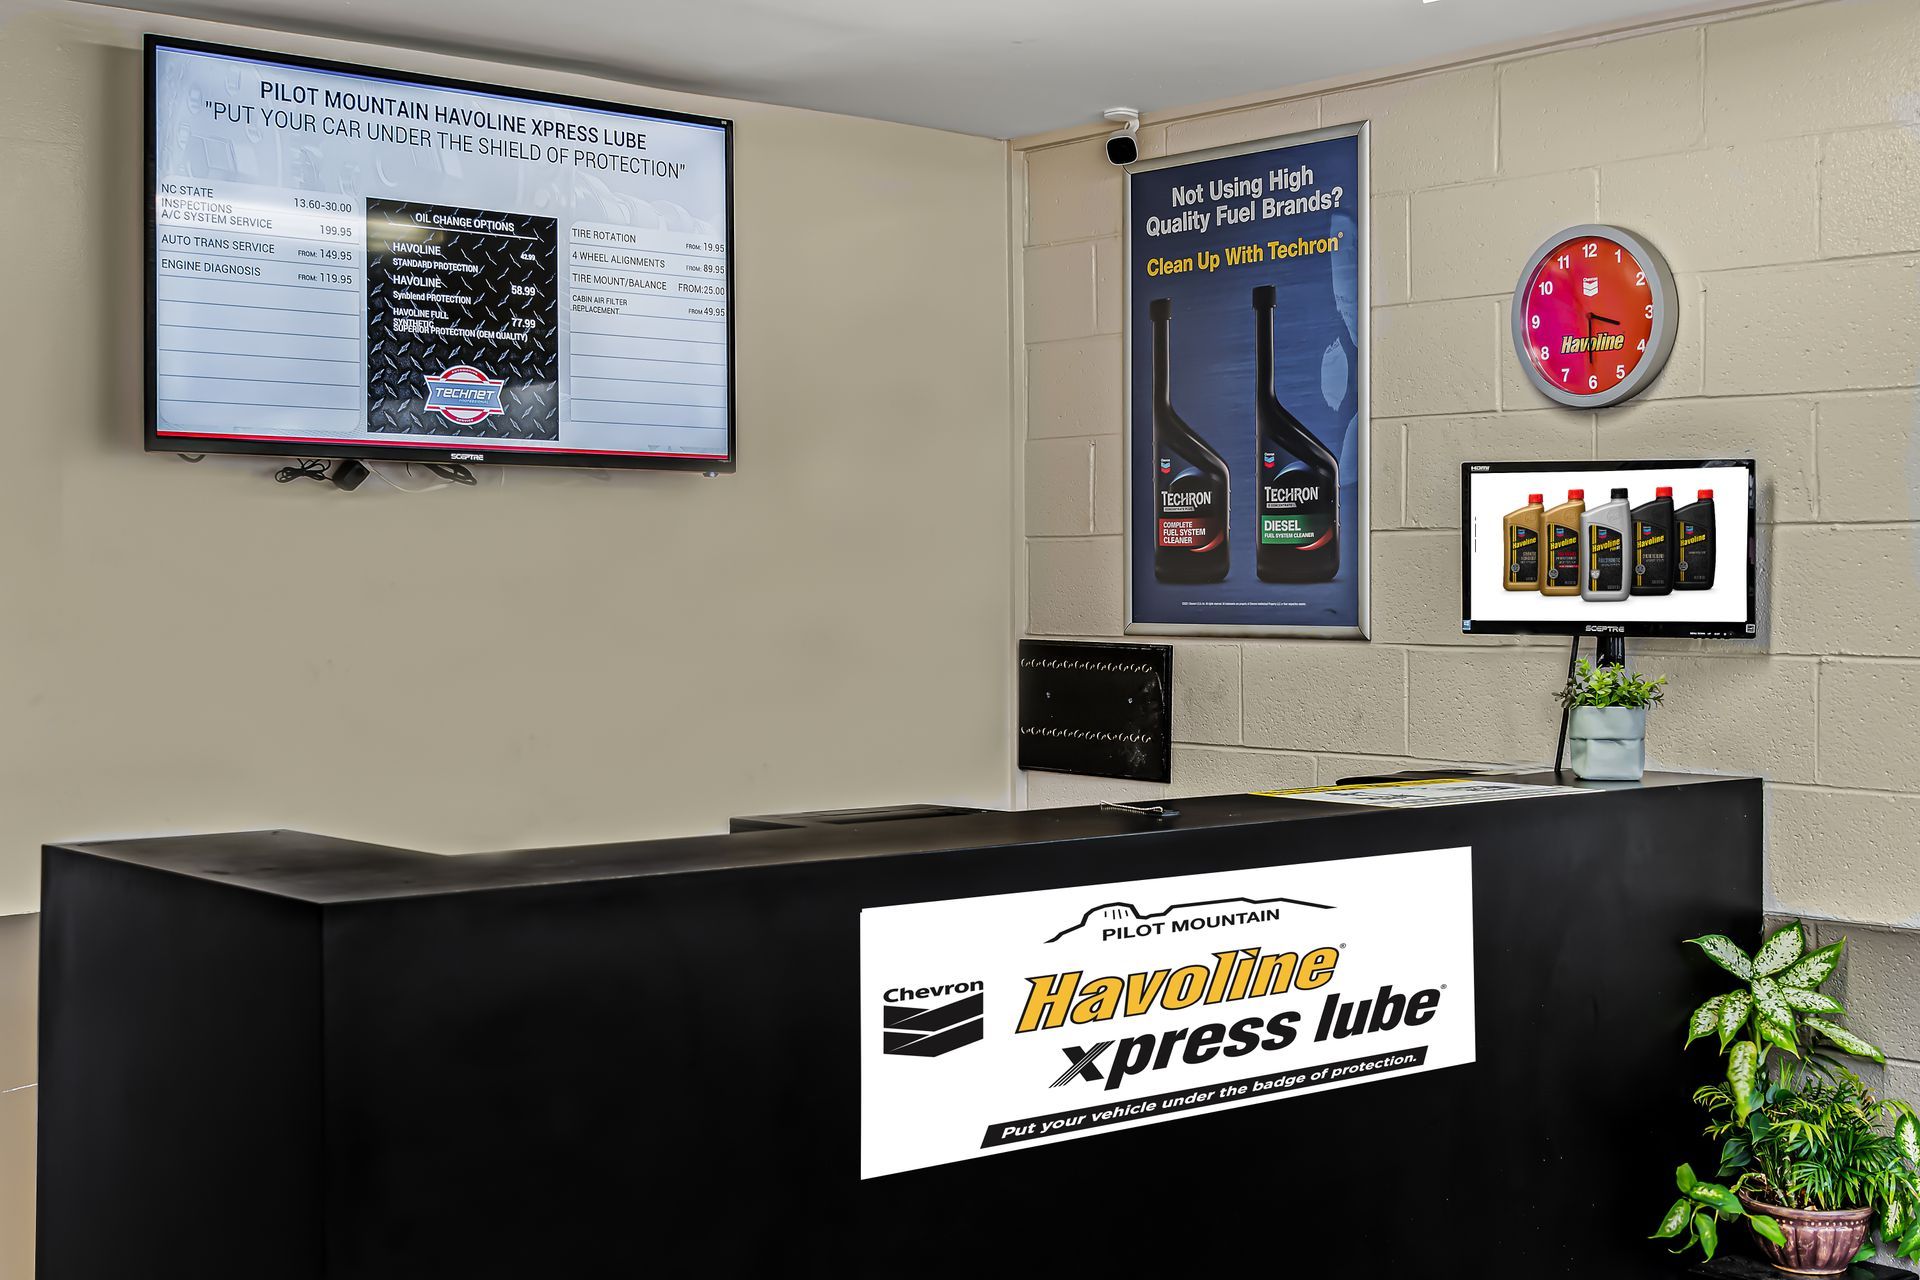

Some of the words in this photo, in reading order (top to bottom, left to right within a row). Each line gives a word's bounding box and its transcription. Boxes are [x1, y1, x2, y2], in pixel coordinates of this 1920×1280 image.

[260, 81, 318, 106] PILOT
[325, 90, 429, 121] MOUNTAIN
[435, 105, 526, 134] HAVOLINE
[531, 118, 599, 143] XPRESS
[604, 128, 647, 150] LUBE
[205, 100, 254, 124] "PUT
[261, 108, 316, 133] YOUR
[322, 117, 361, 139] CAR
[367, 122, 432, 148] UNDER
[437, 131, 473, 152] THE
[478, 137, 541, 161] SHIELD
[547, 146, 569, 164] OF
[574, 150, 686, 179] PROTECTION"
[161, 183, 177, 194] NC
[180, 185, 214, 198] STATE
[1172, 184, 1204, 207] Not
[1209, 176, 1263, 201] Using
[1269, 165, 1314, 192] High
[161, 198, 232, 214] INSPECTIONS
[294, 198, 352, 213] 13.60-30.00
[1146, 208, 1211, 237] Quality
[1216, 200, 1256, 226] Fuel
[1262, 186, 1344, 220] Brands?
[161, 209, 181, 220] A/C
[184, 212, 227, 225] SYSTEM
[230, 216, 273, 229] SERVICE
[415, 213, 431, 224] OIL
[433, 214, 472, 228] CHANGE
[473, 219, 515, 232] OPTIONS
[320, 225, 352, 237] 199.95
[572, 228, 591, 239] TIRE
[593, 231, 636, 243] ROTATION
[161, 234, 191, 246] AUTO
[194, 237, 230, 249] TRANS
[232, 240, 275, 254] SERVICE
[393, 242, 441, 256] HAVOLINE
[703, 242, 725, 253] 19.95
[1582, 243, 1598, 258] 12
[320, 249, 352, 261] 149.95
[572, 251, 578, 260] 4
[579, 252, 609, 263] WHEEL
[610, 255, 666, 268] ALIGNMENTS
[1147, 257, 1193, 277] Clean
[1197, 251, 1220, 272] Up
[1225, 244, 1264, 266] With
[1557, 255, 1570, 270] 11
[1614, 249, 1621, 263] 1
[161, 258, 201, 271] ENGINE
[204, 262, 261, 277] DIAGNOSIS
[393, 258, 433, 269] STANDARD
[433, 262, 479, 273] PROTECTION
[703, 264, 725, 274] 89.95
[320, 272, 353, 285] 119.95
[393, 275, 441, 289] HAVOLINE
[572, 273, 591, 283] TIRE
[593, 275, 667, 291] MOUNT/BALANCE
[1636, 271, 1646, 286] 2
[511, 285, 536, 297] 58.99
[1538, 281, 1553, 296] 10
[426, 294, 472, 305] PROTECTION
[572, 295, 593, 303] CABIN
[606, 298, 628, 306] FILTER
[393, 308, 430, 318] HAVOLINE
[431, 311, 449, 320] FULL
[572, 304, 620, 315] REPLACEMENT
[703, 307, 725, 317] 49.95
[1645, 304, 1653, 319] 3
[511, 317, 536, 329] 77.99
[1531, 315, 1540, 329] 9
[393, 325, 431, 334] SUPERIOR
[432, 327, 476, 338] PROTECTION
[1561, 332, 1625, 354] Havoline
[1637, 338, 1646, 353] 4
[1541, 346, 1550, 360] 8
[1561, 368, 1570, 382] 7
[1616, 364, 1626, 379] 5
[1588, 375, 1598, 389] 6
[450, 453, 484, 461] SCEPTRE
[1161, 491, 1211, 508] TECHRON
[1264, 486, 1318, 504] TECHRON
[1163, 521, 1193, 529] COMPLETE
[1179, 528, 1206, 536] SYSTEM
[1264, 520, 1302, 531] DIESEL
[1585, 625, 1625, 633] SCEPTRE
[1102, 922, 1165, 941] PILOT
[1171, 909, 1280, 933] MOUNTAIN
[883, 980, 985, 1003] Chevron
[1049, 1011, 1301, 1091] xpress
[1001, 1122, 1036, 1139] Put
[1040, 1116, 1087, 1133] your
[1091, 1101, 1157, 1122] vehicle
[1162, 1091, 1216, 1109] under
[1219, 1084, 1248, 1098] the
[1252, 1075, 1306, 1092] badge
[1310, 1068, 1330, 1080] of
[1331, 1053, 1417, 1079] protection.
